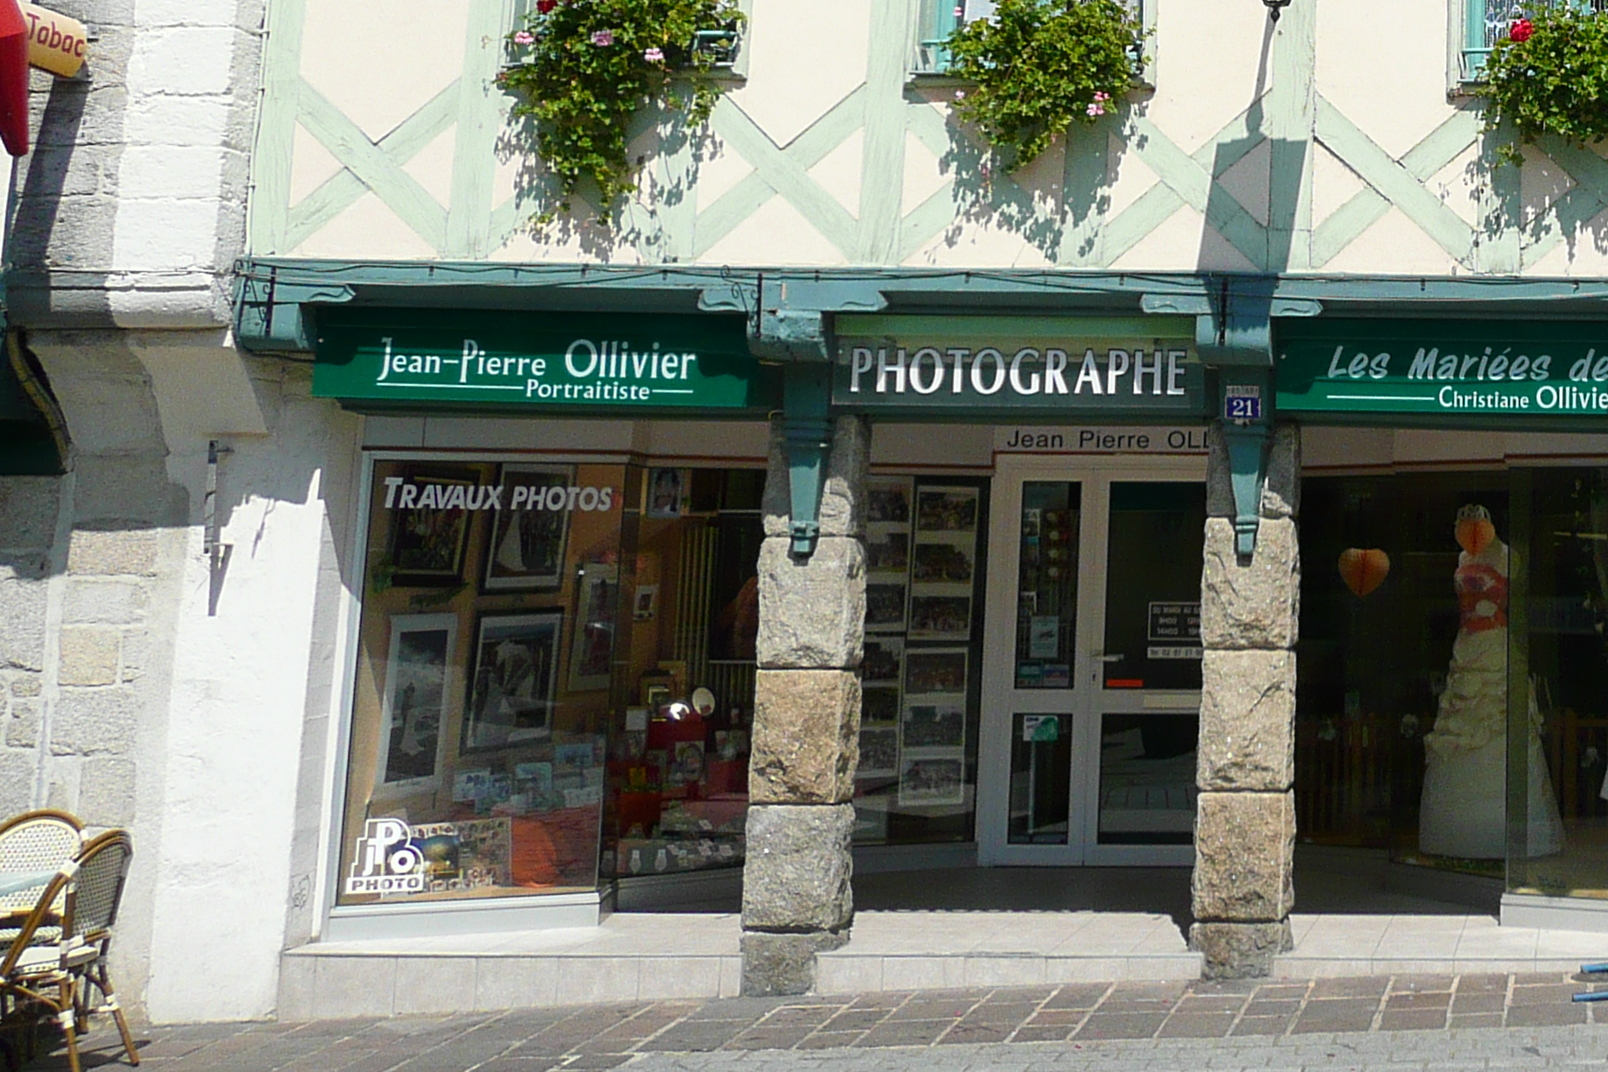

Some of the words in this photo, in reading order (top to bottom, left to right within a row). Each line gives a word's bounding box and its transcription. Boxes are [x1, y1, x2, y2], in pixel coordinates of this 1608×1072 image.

[26, 12, 85, 58] Tabac
[377, 336, 546, 384] Jean-Pierre
[564, 338, 697, 380] Ollivier
[849, 346, 1187, 396] PHOTOGRAPHE
[1327, 346, 1391, 379] Les
[1407, 346, 1550, 381] Mariées
[525, 378, 650, 401] Portraitiste
[1438, 385, 1530, 410] Christiane
[1232, 399, 1253, 416] 21
[1007, 430, 1063, 448] Jean
[1079, 430, 1150, 449] Pierre
[383, 476, 504, 510] TRAVAUX
[510, 485, 614, 512] PHOTOS
[352, 877, 420, 891] PHOTO
